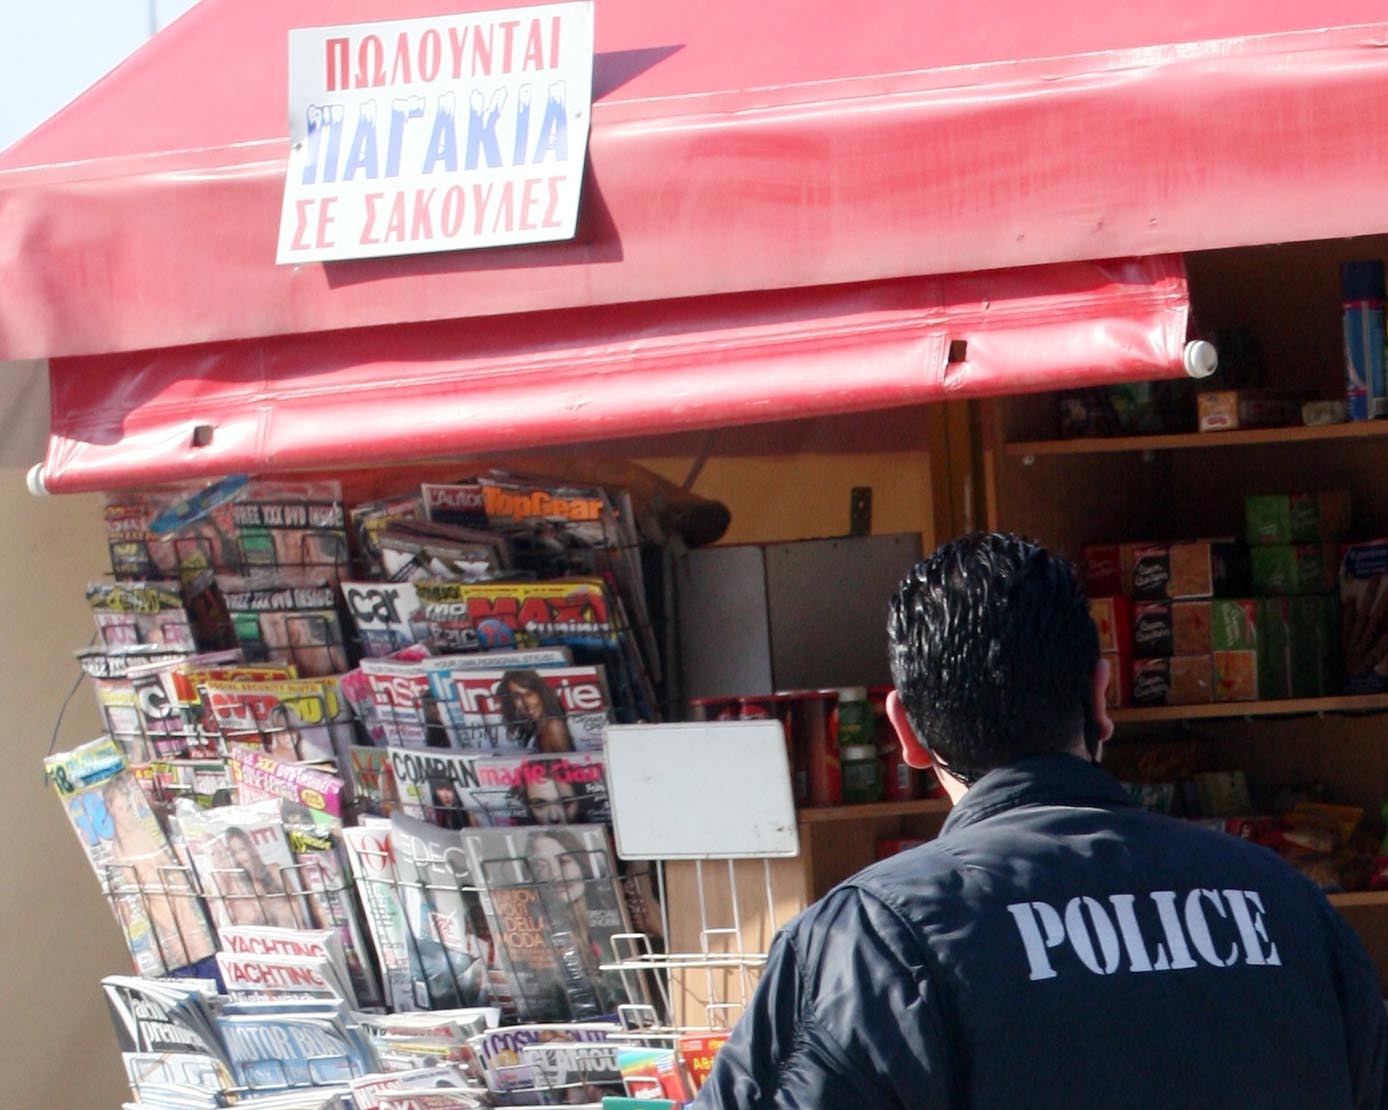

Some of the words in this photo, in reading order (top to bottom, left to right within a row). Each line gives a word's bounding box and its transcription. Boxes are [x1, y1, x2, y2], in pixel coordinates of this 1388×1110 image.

[325, 16, 563, 93] ΠΩΛΟΥΝΤΑΙ
[301, 80, 569, 186] ΠΑΓΑΚΙΑ
[289, 206, 336, 252] ΣΕ
[359, 175, 568, 246] ΣΑΚΟΥΛΕΣ
[487, 484, 603, 522] TopGear
[347, 586, 402, 623] car
[478, 757, 547, 787] marie
[551, 754, 605, 783] clair
[1007, 887, 1282, 981] POLICE
[223, 961, 326, 987] YACHTING
